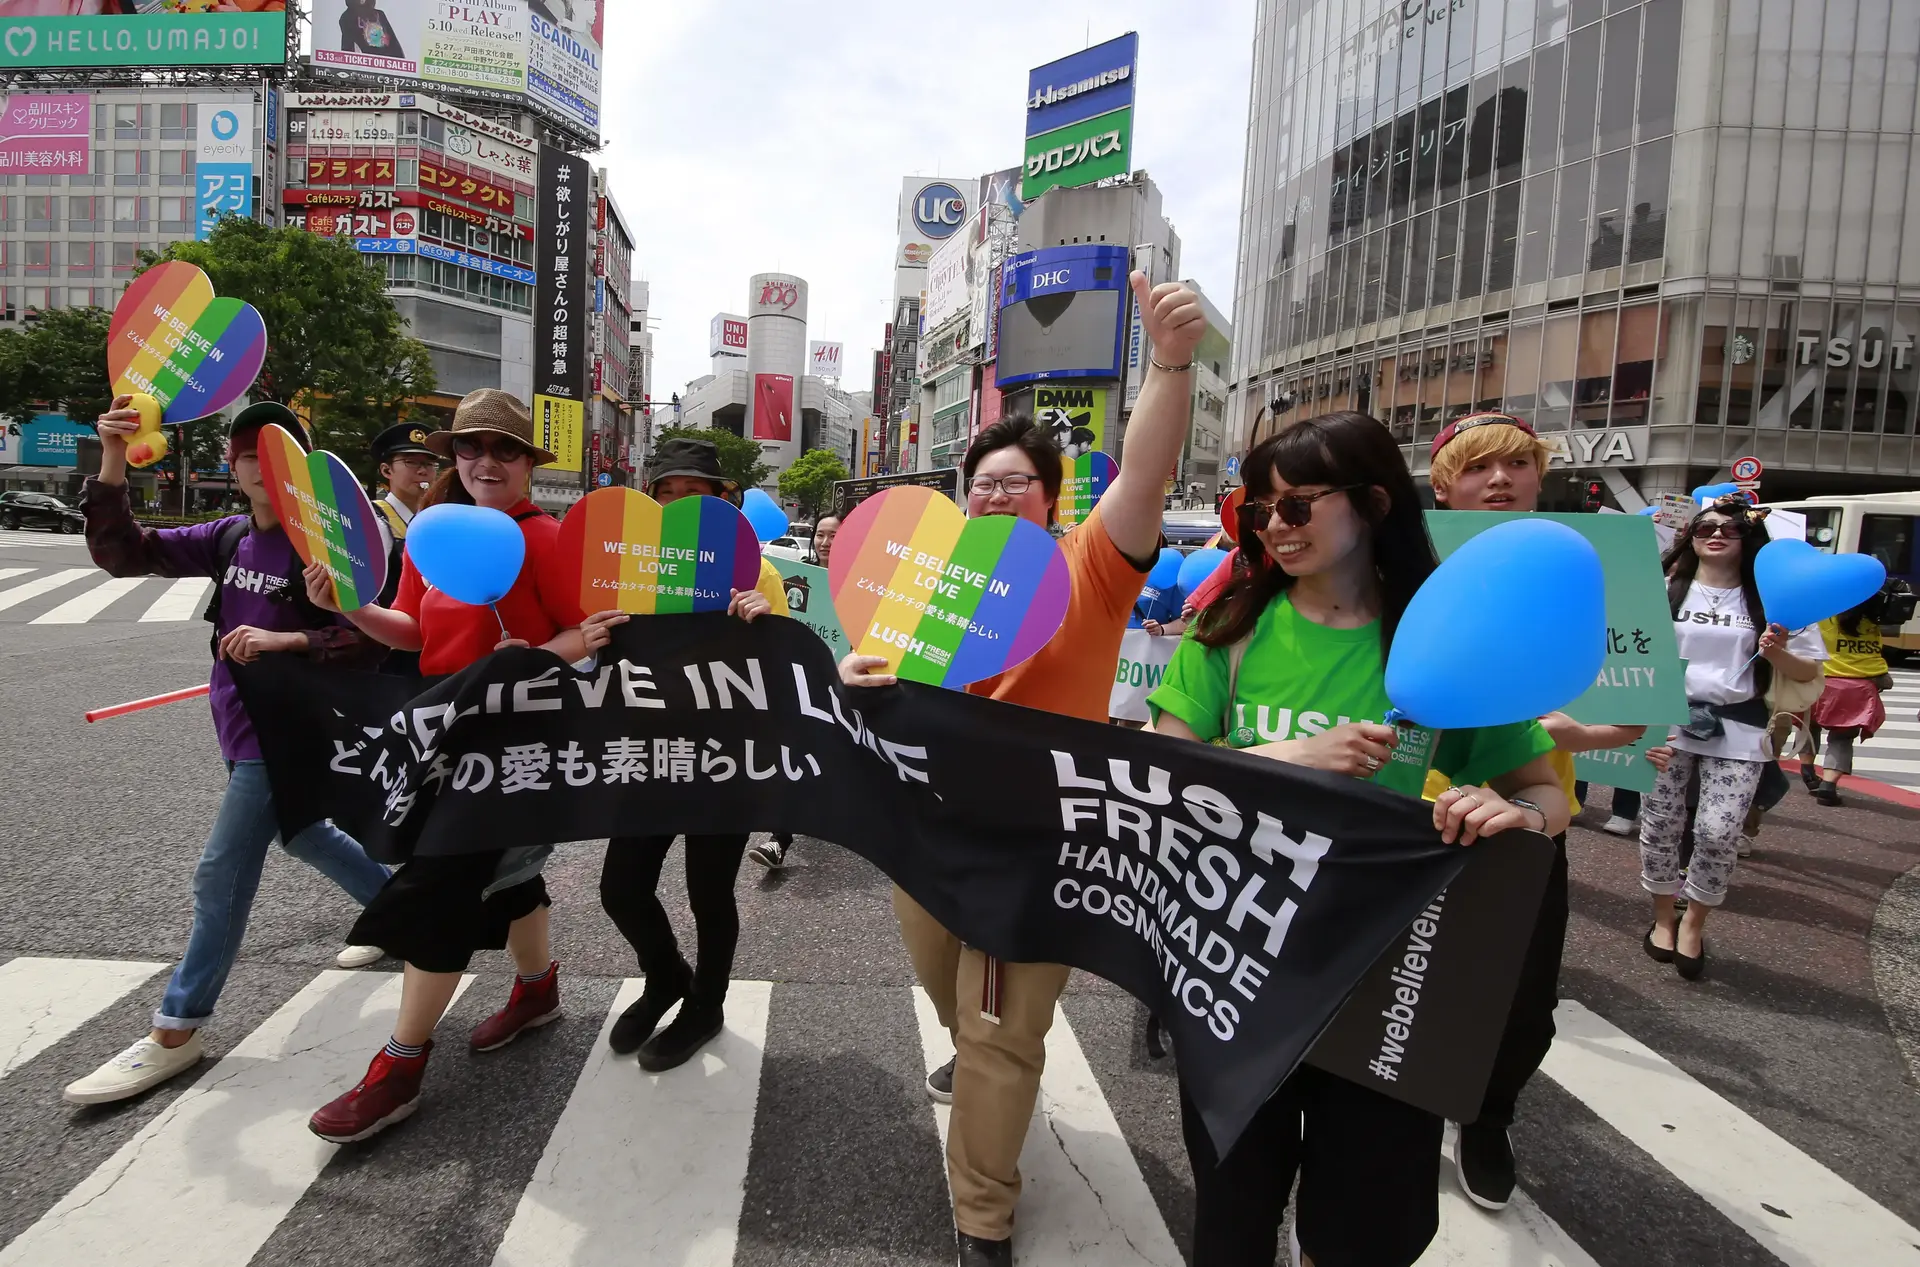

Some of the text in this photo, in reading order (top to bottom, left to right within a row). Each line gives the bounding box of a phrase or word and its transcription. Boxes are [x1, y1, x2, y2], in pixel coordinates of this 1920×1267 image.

[48, 28, 259, 51] HELLO, UMAJO!
[470, 25, 522, 42] Release!!
[531, 14, 599, 71] SCANDAL
[344, 54, 372, 67] TICKET
[373, 59, 385, 68] ON
[386, 60, 415, 72] SALE!!
[28, 102, 84, 116] 品川スキン
[298, 94, 391, 106] しゃぶしゃぶバイキング
[28, 117, 78, 129] クリニック
[290, 121, 306, 133] 9F
[437, 102, 533, 147] しゃぶしゃぶバイキング
[0, 151, 84, 167] 品川美容外科
[203, 143, 245, 156] eyecity
[477, 140, 532, 174] しゃぶ葉
[1026, 130, 1121, 176] サロンパス
[1332, 117, 1467, 197] ナイジェリア
[310, 161, 392, 179] プライス
[420, 164, 511, 207] コンタクト
[359, 191, 400, 208] ガスト
[310, 215, 333, 226] Café
[336, 213, 386, 236] ガスト
[485, 216, 525, 239] ガスト
[422, 245, 534, 281] AEON 英会話イーオン
[1032, 269, 1070, 289] DHC
[758, 286, 798, 310] 109
[153, 304, 225, 363] WE BELIEVE IN
[725, 334, 745, 345] QLO
[726, 323, 744, 334] UNI
[164, 333, 193, 359] LOVE
[814, 346, 839, 364] H&M
[1797, 336, 1913, 370] TSUT
[124, 367, 157, 396] LUSH
[1037, 390, 1094, 407] DMM
[1038, 408, 1073, 427] FX
[1063, 477, 1091, 485] BELIEVE
[284, 481, 352, 530] WE BELIEVE IN
[1060, 508, 1080, 516] LUSH
[308, 511, 334, 534] LOVE
[603, 541, 715, 564] WE BELIEVE IN
[638, 561, 678, 576] LOVE
[885, 540, 1011, 598] WE BELIEVE IN
[266, 574, 291, 588] FRES
[591, 578, 720, 599] どんなカタチの愛も素晴らしい
[913, 572, 961, 600] LOVE
[855, 576, 1000, 641] どんなカタチの愛も素晴らしい
[869, 621, 951, 659] LUSH FRESH
[1836, 639, 1882, 655] PRESS
[683, 658, 769, 711] IN
[1050, 749, 1333, 893] LUSH
[1060, 797, 1299, 959] FRESH
[1057, 842, 1270, 1002] HANDMADE
[1053, 877, 1240, 1042] COSMETICS
